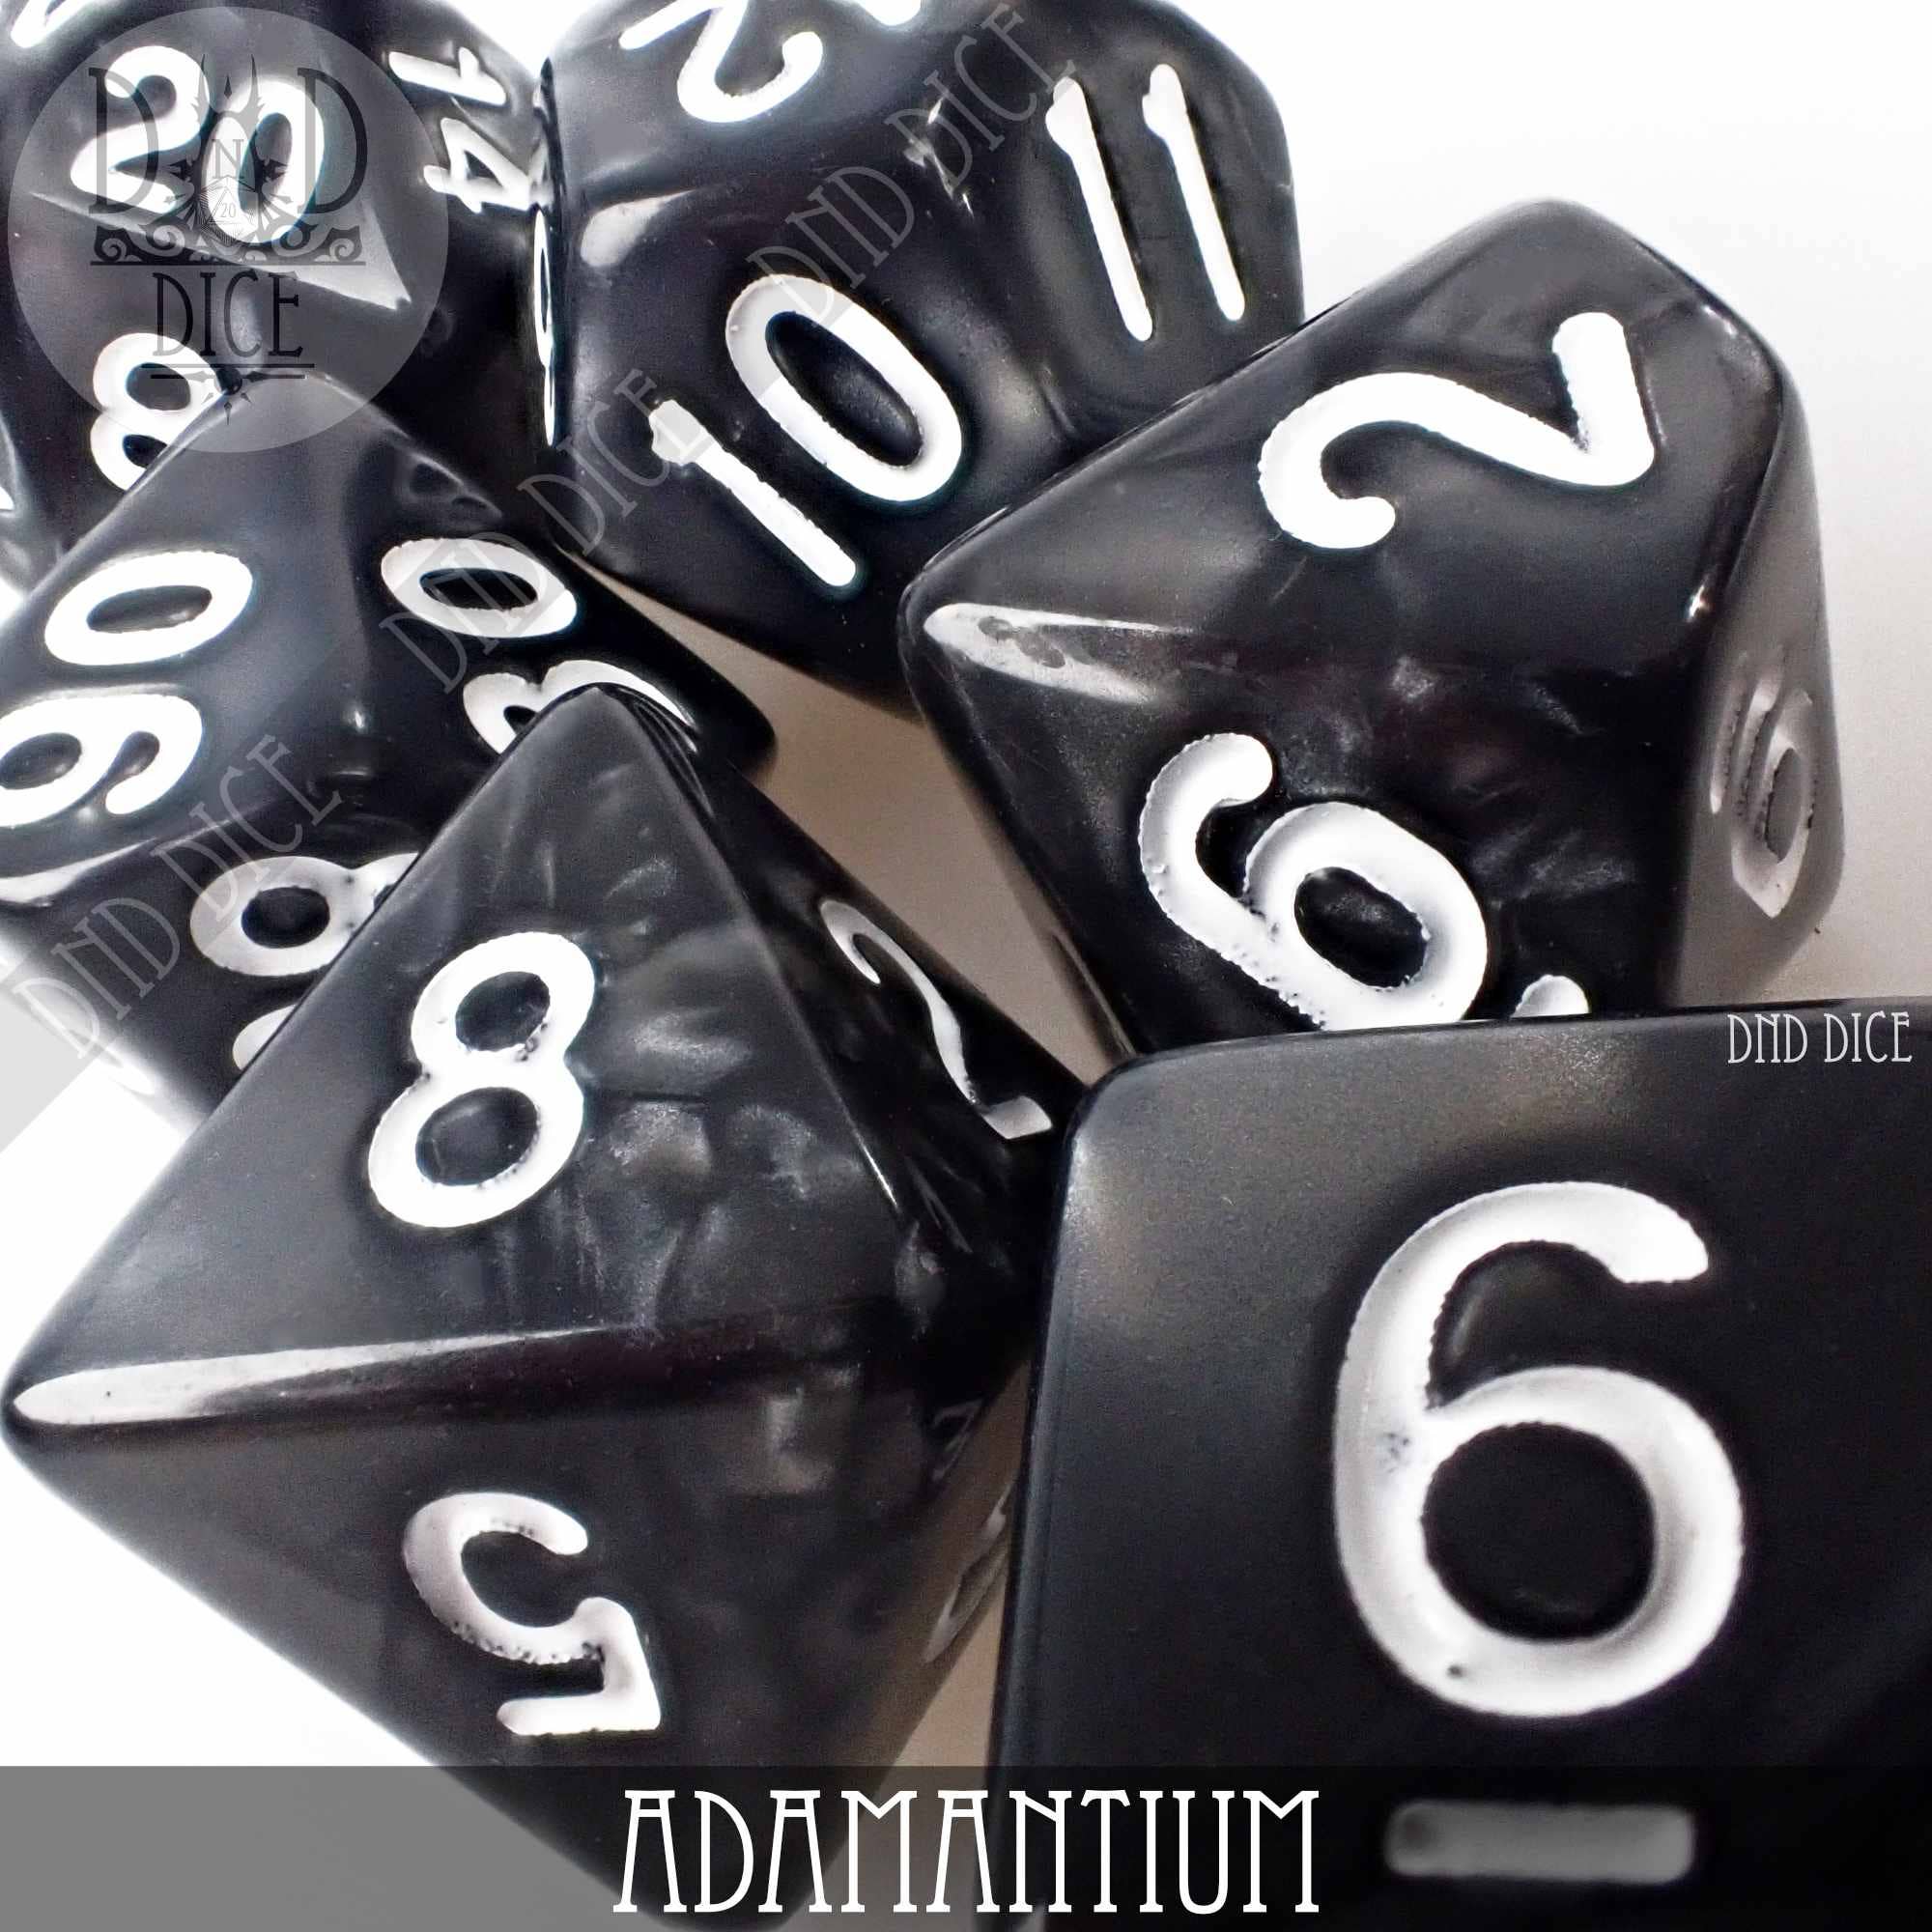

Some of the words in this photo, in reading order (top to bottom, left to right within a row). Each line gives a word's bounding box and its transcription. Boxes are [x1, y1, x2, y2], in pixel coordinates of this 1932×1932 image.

[70, 45, 325, 244] 20
[388, 46, 533, 213] 14
[1046, 64, 1245, 341] 11
[649, 274, 962, 586] 10
[1259, 312, 1655, 551] 2
[368, 931, 595, 1228] 8
[1333, 1180, 1742, 1719] 6
[403, 1492, 661, 1736] 5
